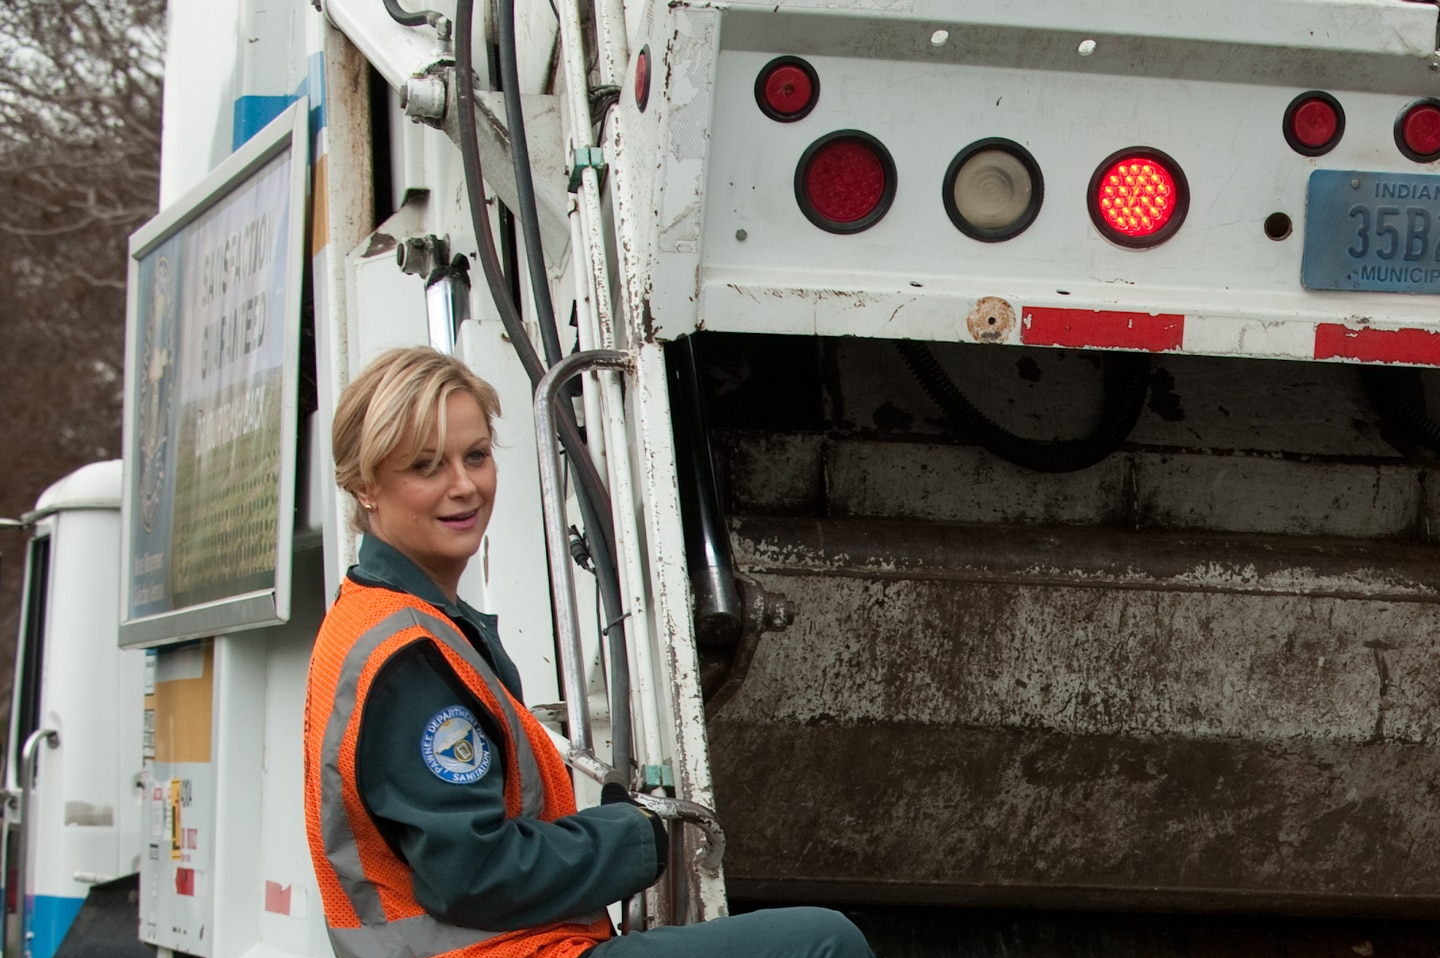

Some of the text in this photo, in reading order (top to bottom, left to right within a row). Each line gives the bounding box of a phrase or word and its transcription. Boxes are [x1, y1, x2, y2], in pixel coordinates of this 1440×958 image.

[423, 709, 487, 775] PAWNEE DEPARTMENT OF
[452, 751, 491, 782] SANITATION
